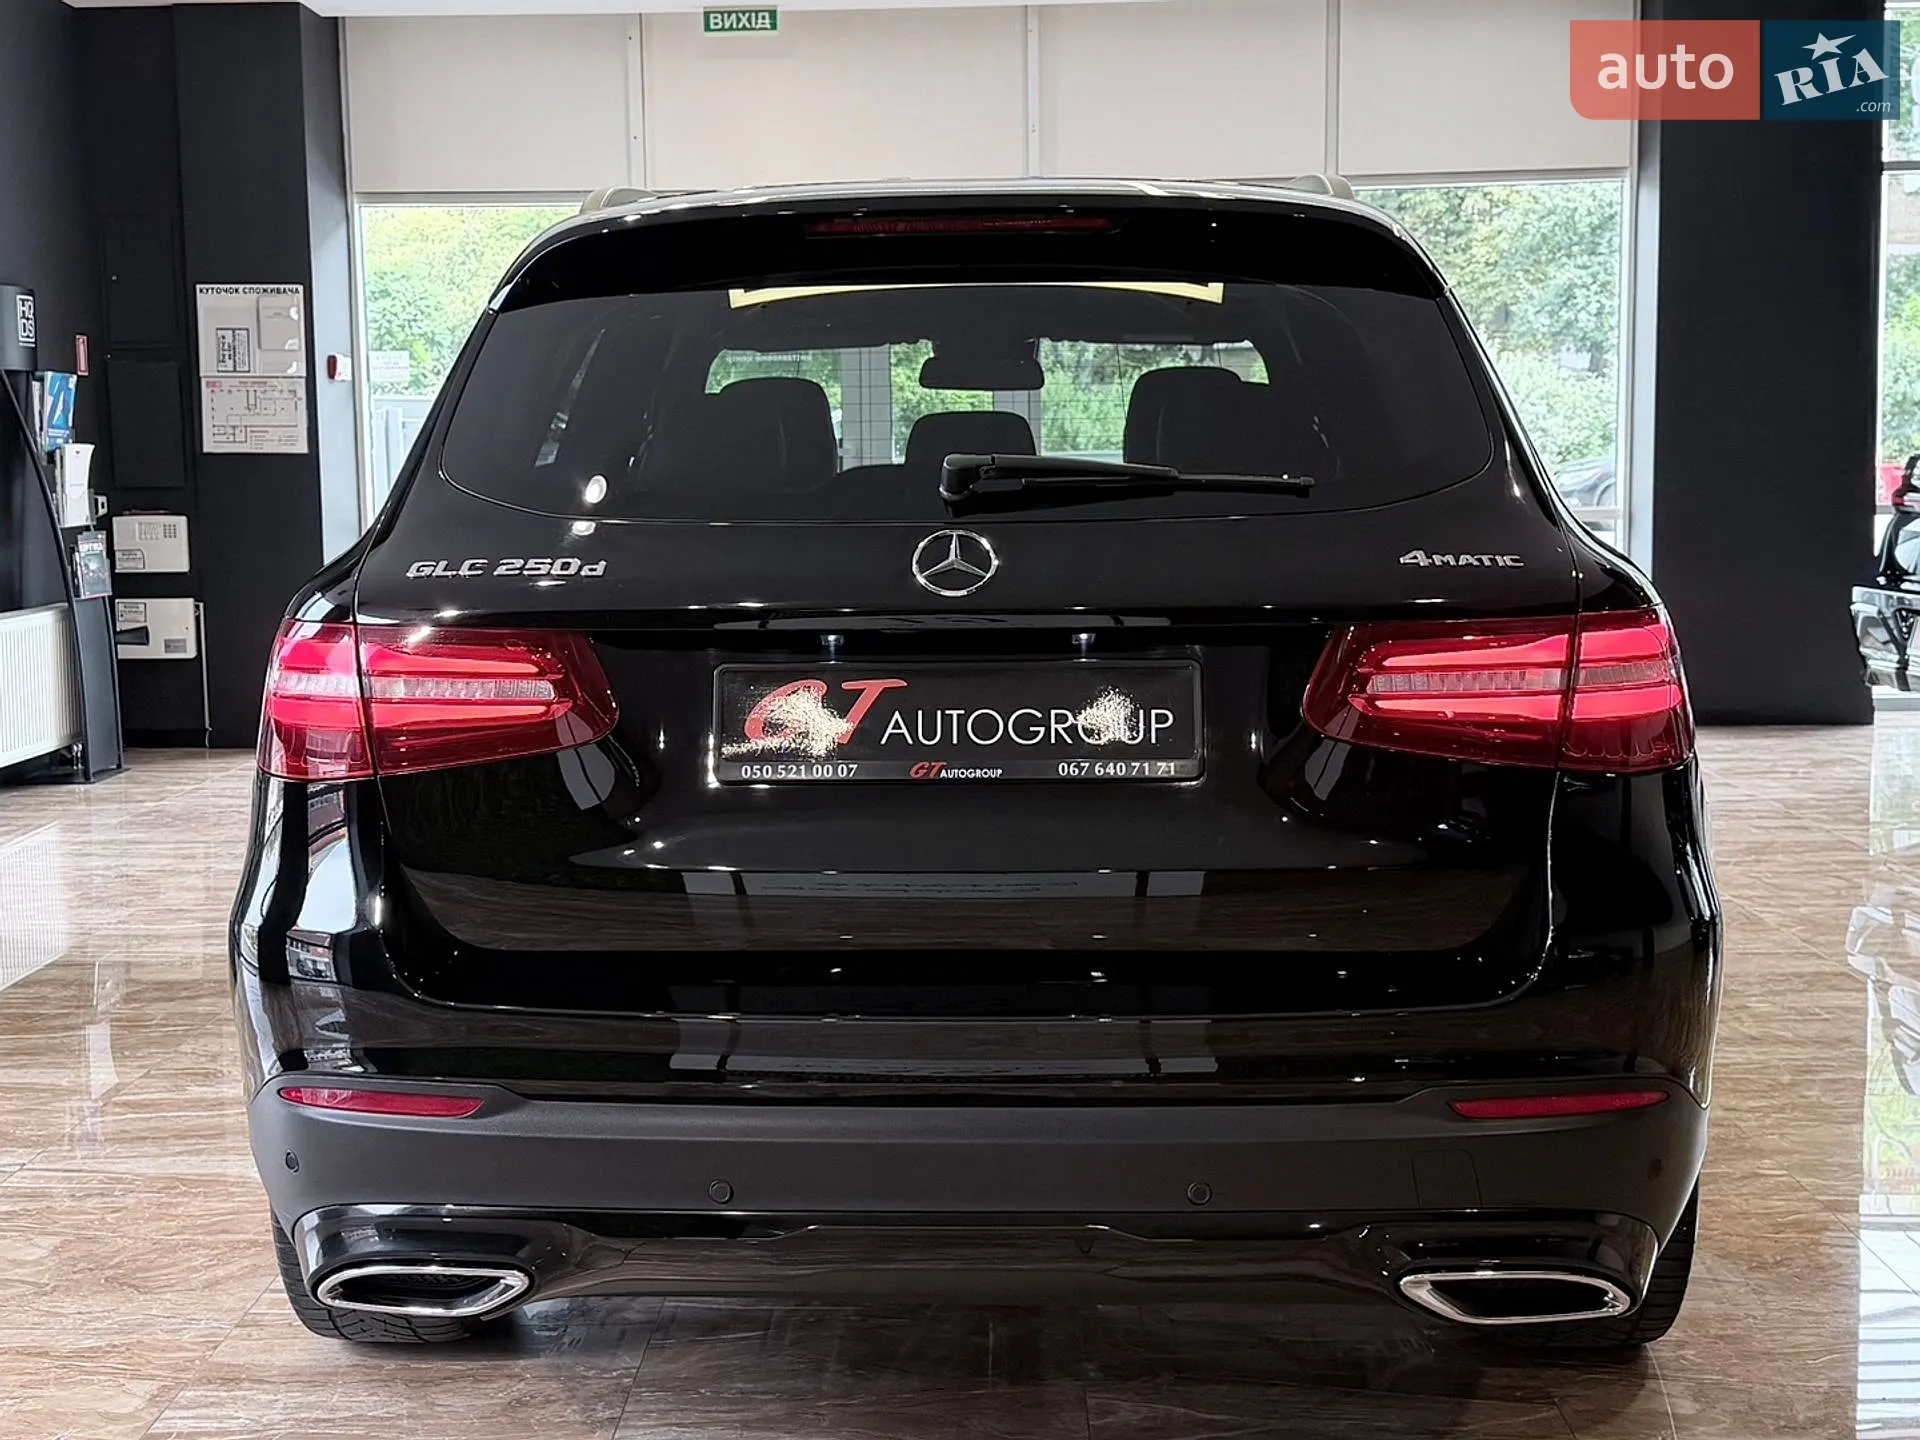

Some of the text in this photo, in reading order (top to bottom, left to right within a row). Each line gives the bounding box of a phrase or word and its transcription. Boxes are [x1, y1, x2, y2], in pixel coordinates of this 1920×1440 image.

[709, 11, 771, 30] ВИХІД
[199, 286, 300, 295] КУТОЧОК СПОЖИВАЧА
[1399, 549, 1525, 567] 4MATIC
[405, 557, 607, 578] GLC 250d
[741, 764, 858, 779] 050 521 00 07
[1058, 762, 1176, 776] 067 640 71 71
